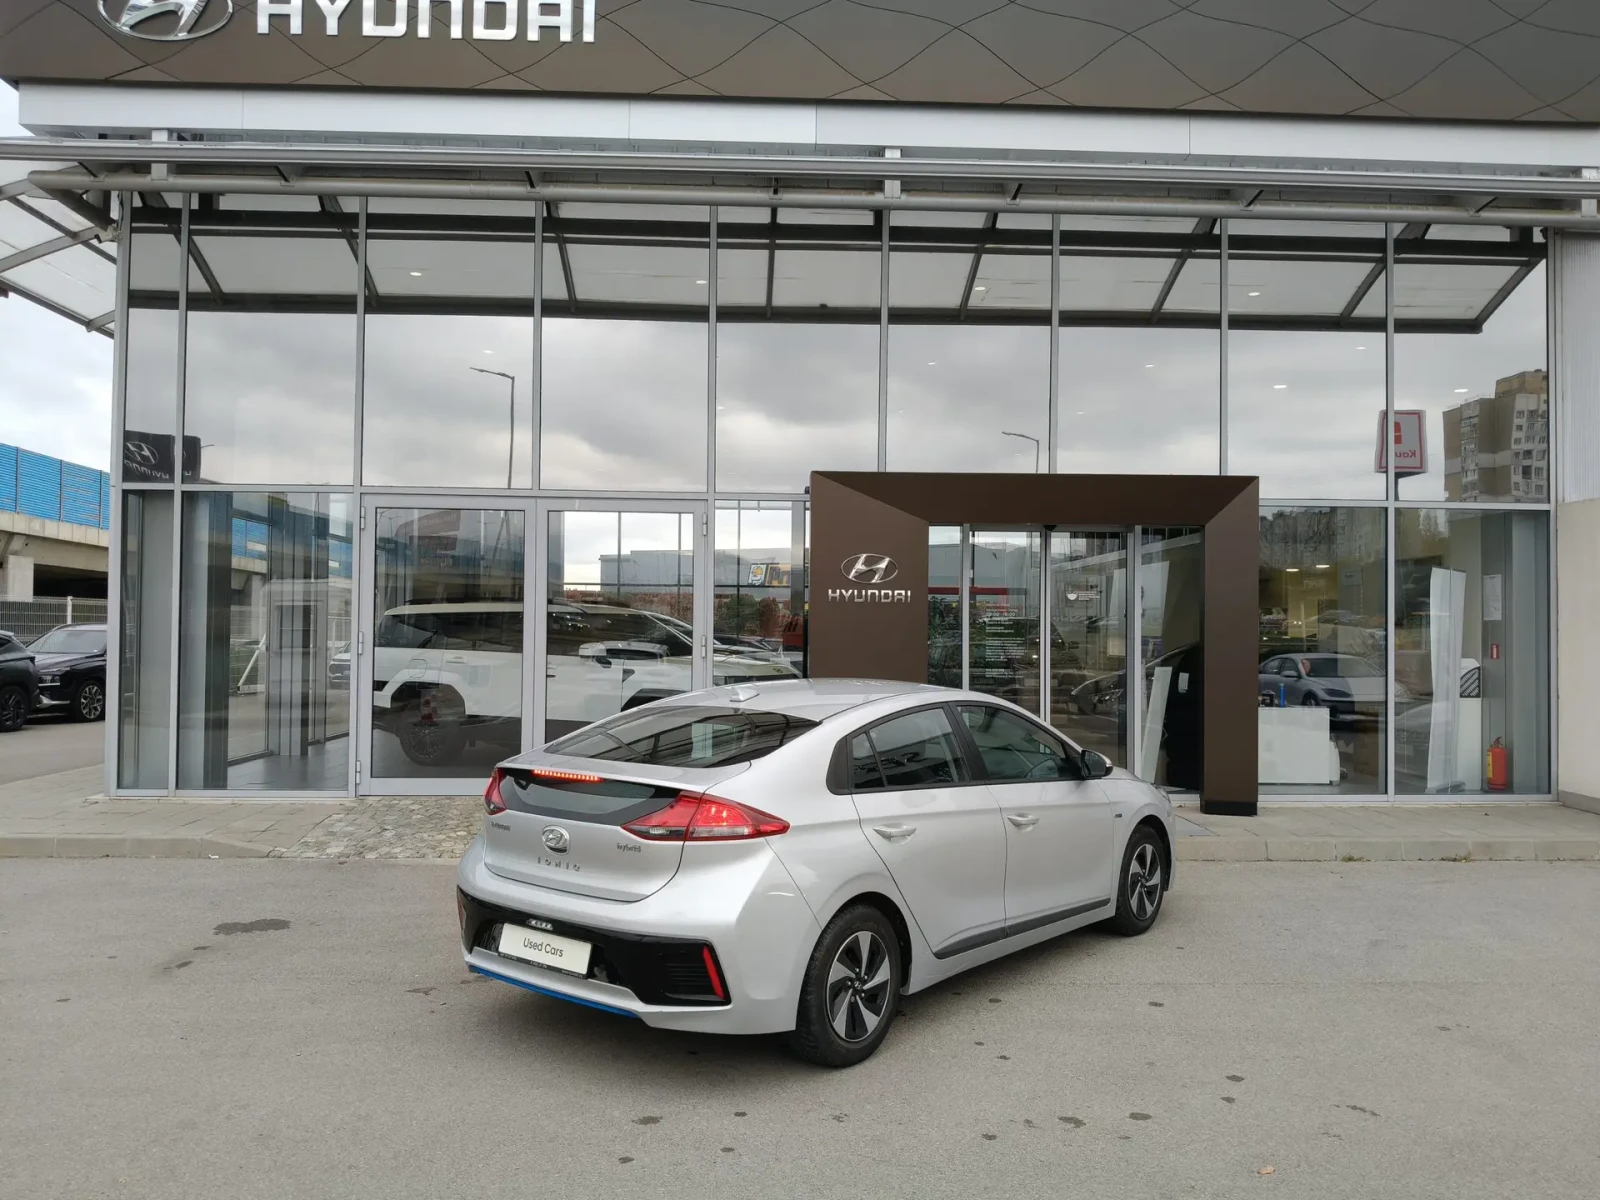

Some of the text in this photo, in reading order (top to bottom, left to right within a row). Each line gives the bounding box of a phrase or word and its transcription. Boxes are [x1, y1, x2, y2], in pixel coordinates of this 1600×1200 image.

[257, 0, 596, 42] HYUNDAI
[828, 589, 911, 602] HYUNDAI
[617, 842, 641, 853] hybrid
[537, 857, 581, 872] IONIQ
[523, 937, 564, 958] Used Cars
